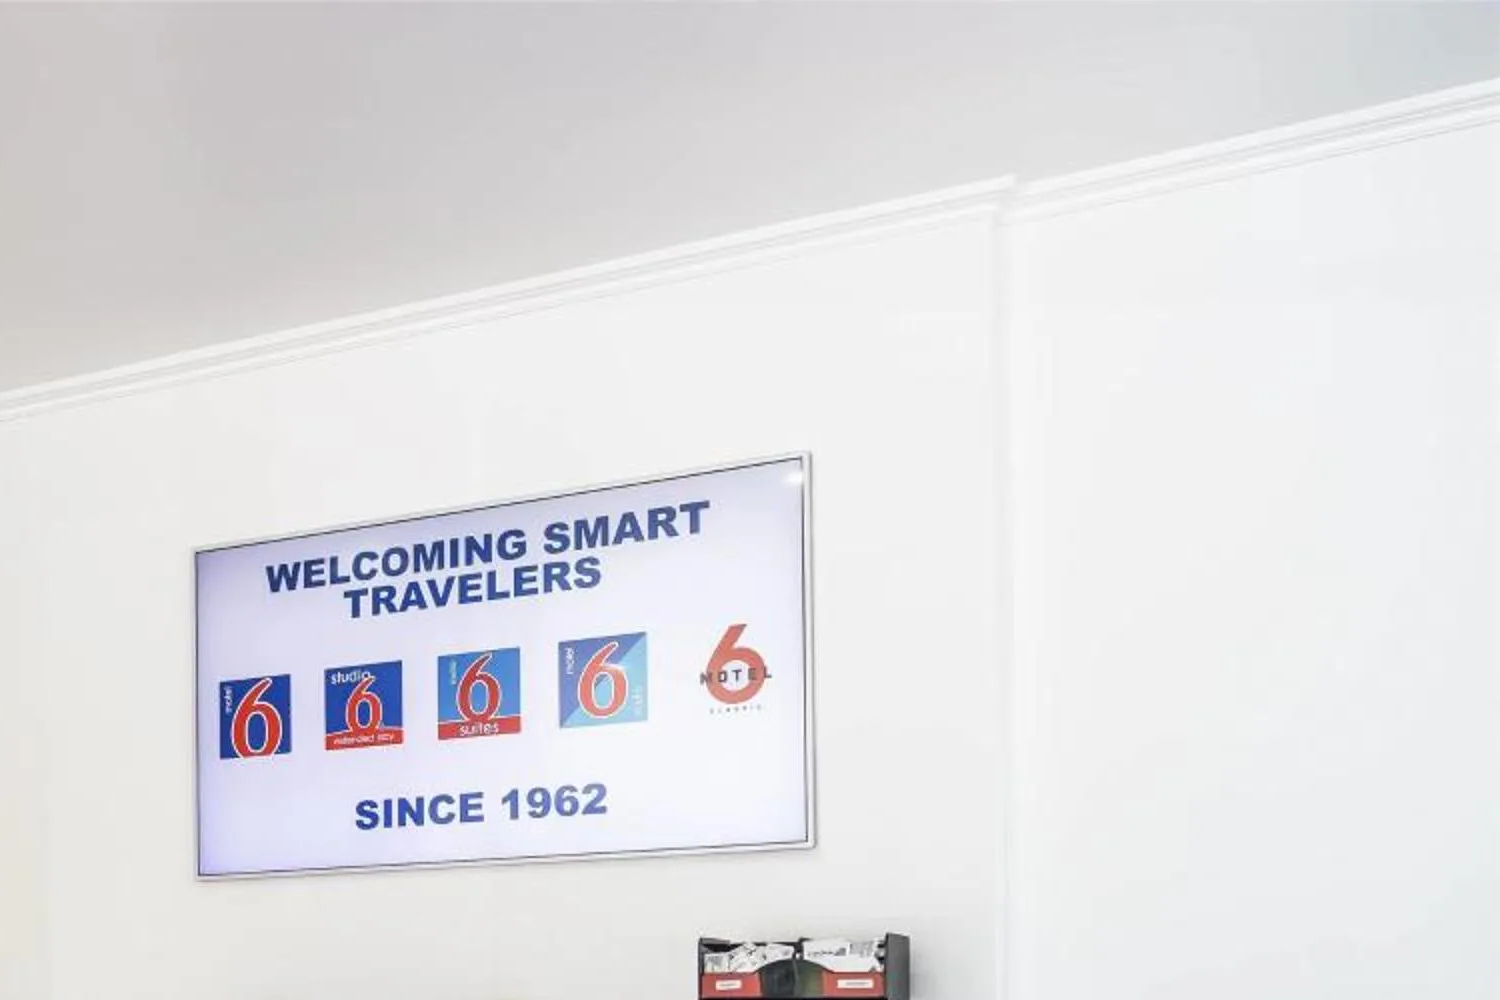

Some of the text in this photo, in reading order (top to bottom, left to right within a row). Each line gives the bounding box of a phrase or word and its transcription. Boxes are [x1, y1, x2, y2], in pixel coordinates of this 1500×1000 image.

[265, 500, 711, 593] WELCOMING SMART
[343, 556, 602, 619] TRAVELERS
[456, 651, 502, 721] 6
[577, 641, 629, 719] 6
[699, 664, 773, 686] MOTEL
[705, 622, 767, 704] 6
[230, 677, 283, 759] 6
[345, 676, 383, 733] 6
[459, 721, 500, 736] suites
[355, 783, 607, 831] SINCE 1962
